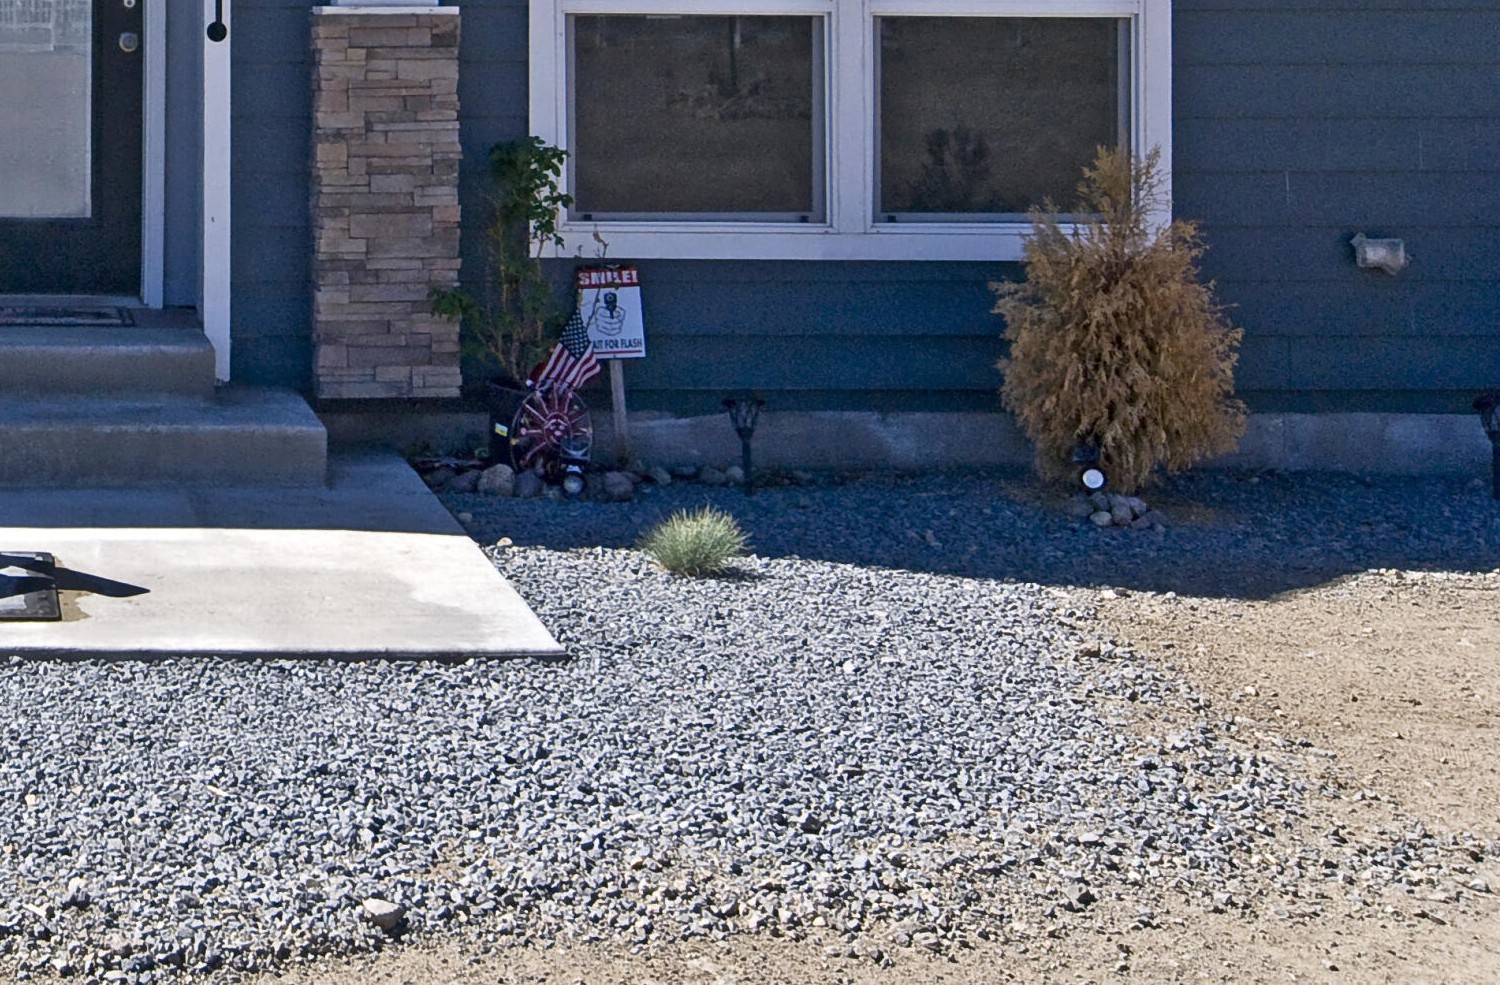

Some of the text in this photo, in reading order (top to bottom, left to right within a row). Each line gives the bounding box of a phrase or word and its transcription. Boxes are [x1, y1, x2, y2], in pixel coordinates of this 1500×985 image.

[592, 338, 643, 350] AIT FOR FLASH
